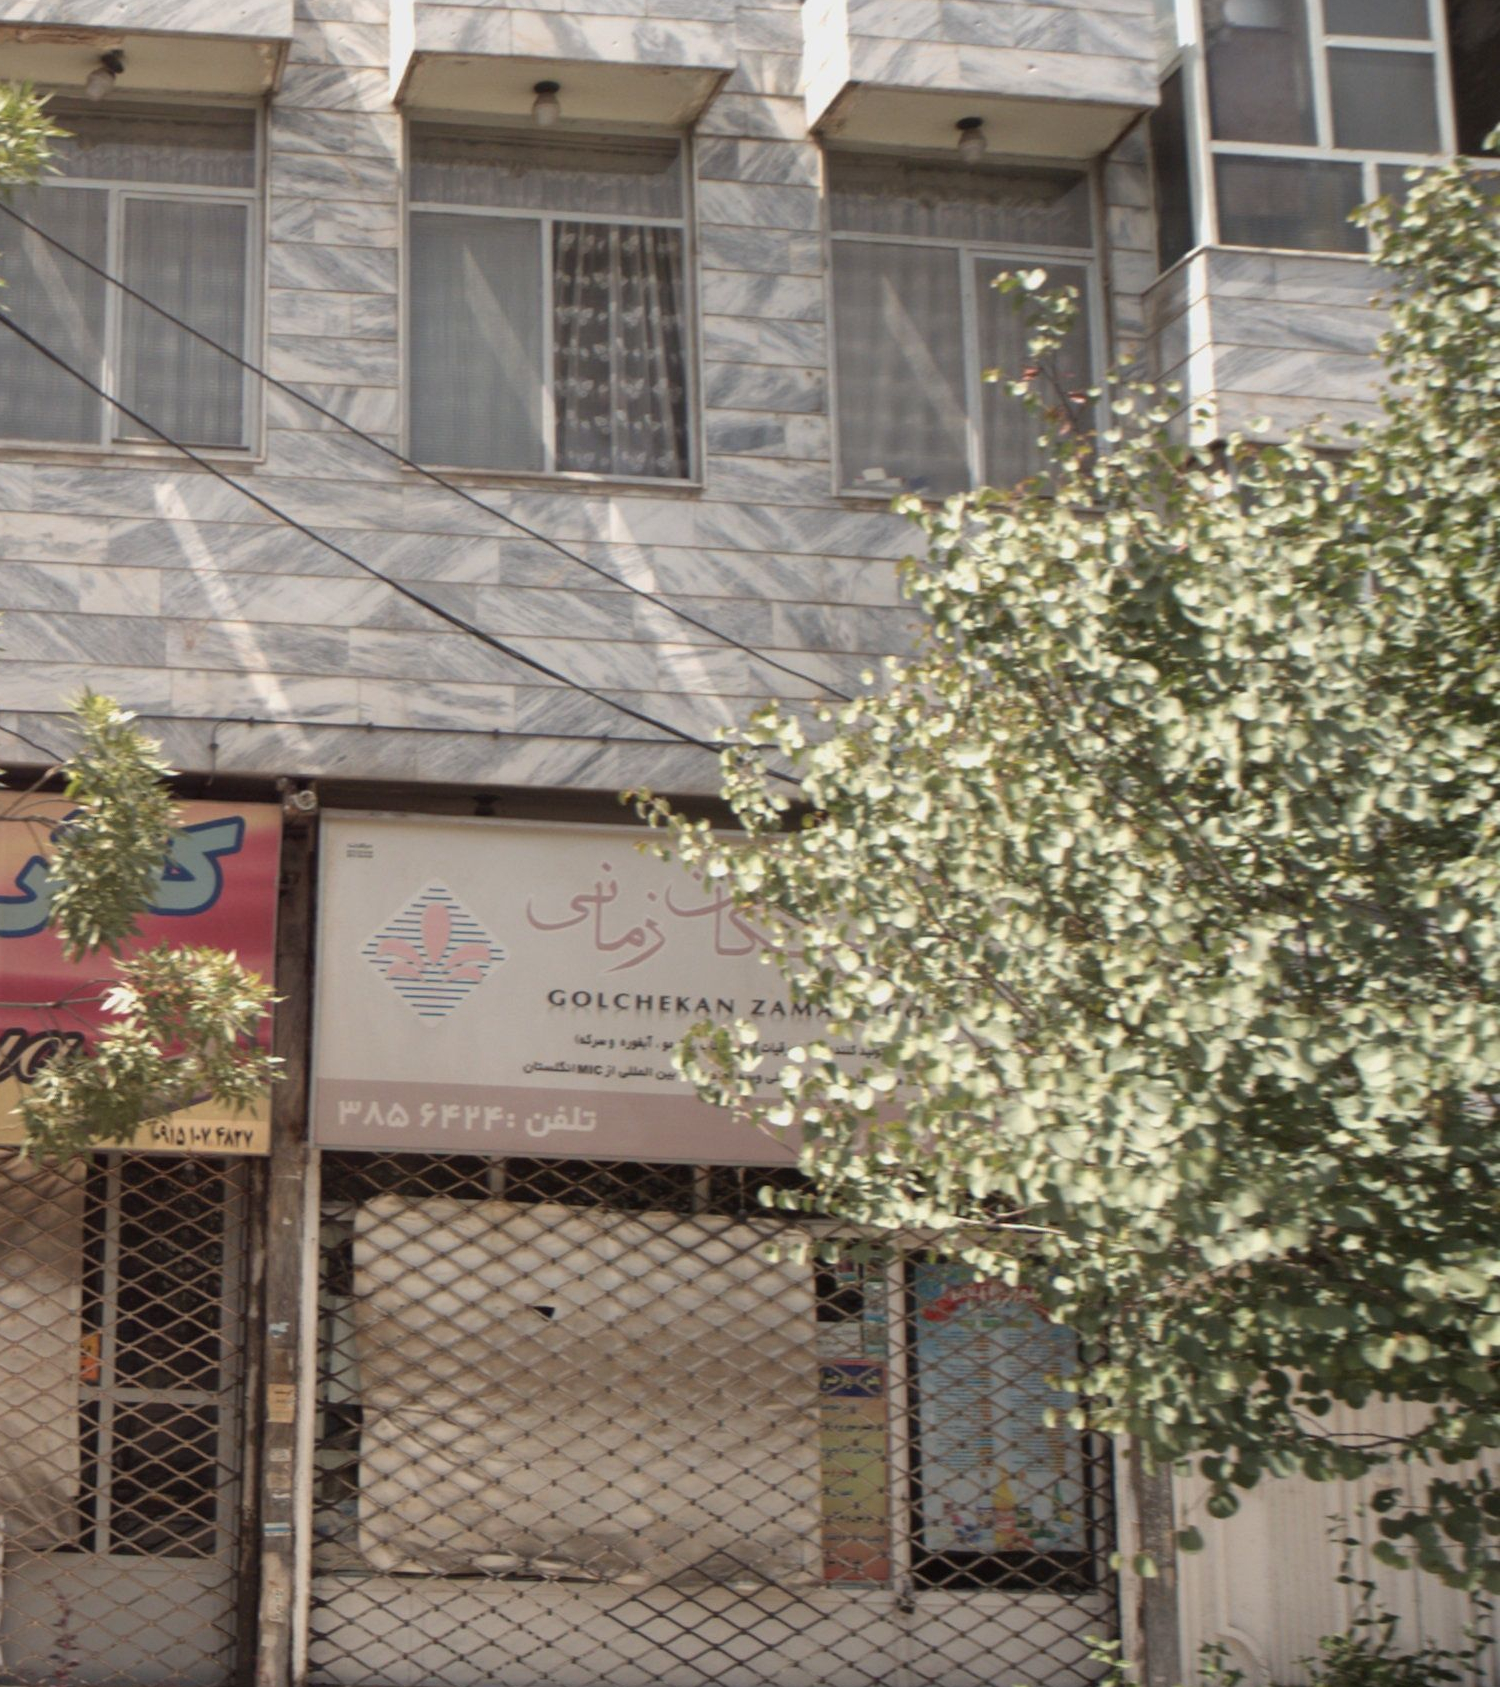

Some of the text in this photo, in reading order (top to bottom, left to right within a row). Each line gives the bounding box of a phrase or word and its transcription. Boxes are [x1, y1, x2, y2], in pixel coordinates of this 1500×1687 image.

[526, 862, 666, 973] زمانی
[547, 989, 735, 1014] GOLCHEKAN
[577, 1063, 604, 1076] MIC
[338, 1100, 410, 1127] ۳۸۵
